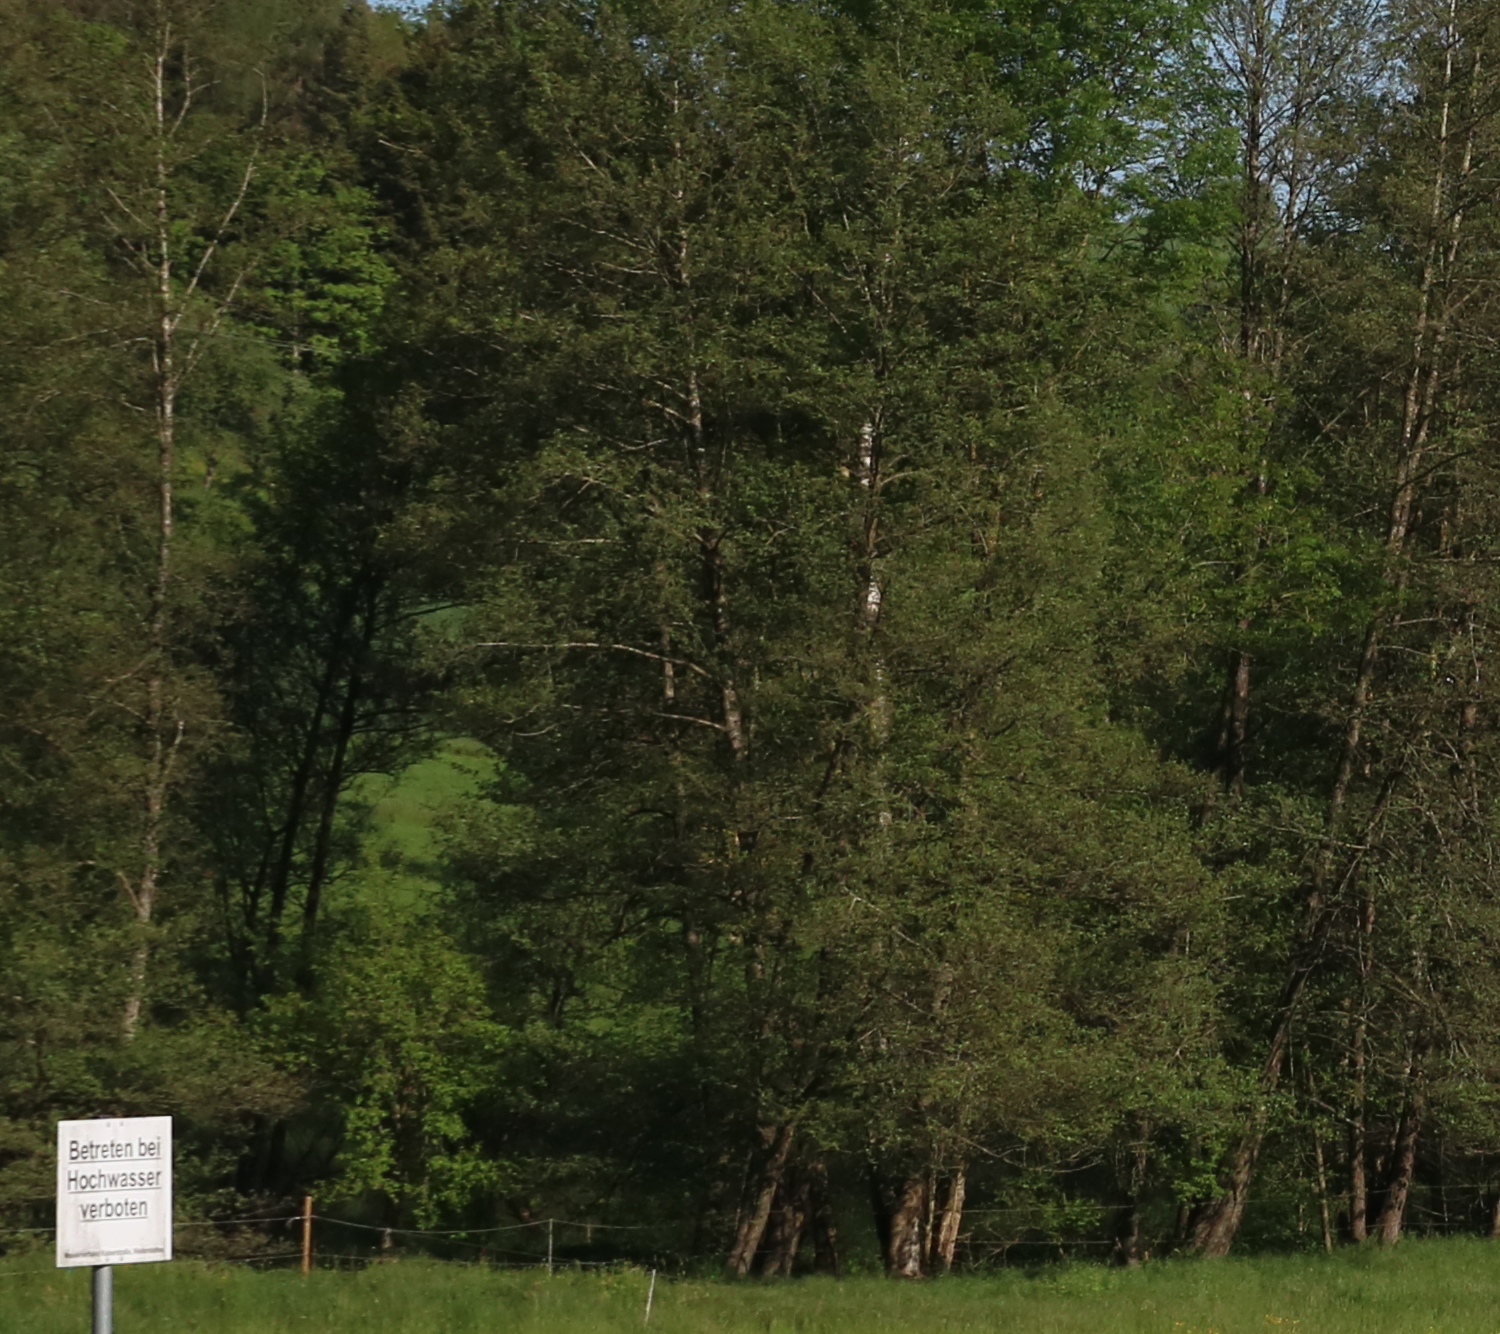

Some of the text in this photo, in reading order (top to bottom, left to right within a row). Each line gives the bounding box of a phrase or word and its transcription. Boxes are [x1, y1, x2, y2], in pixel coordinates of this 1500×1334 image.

[69, 1136, 161, 1161] Betreten bei
[67, 1169, 162, 1190] Hochwasser
[79, 1198, 148, 1219] verboten
